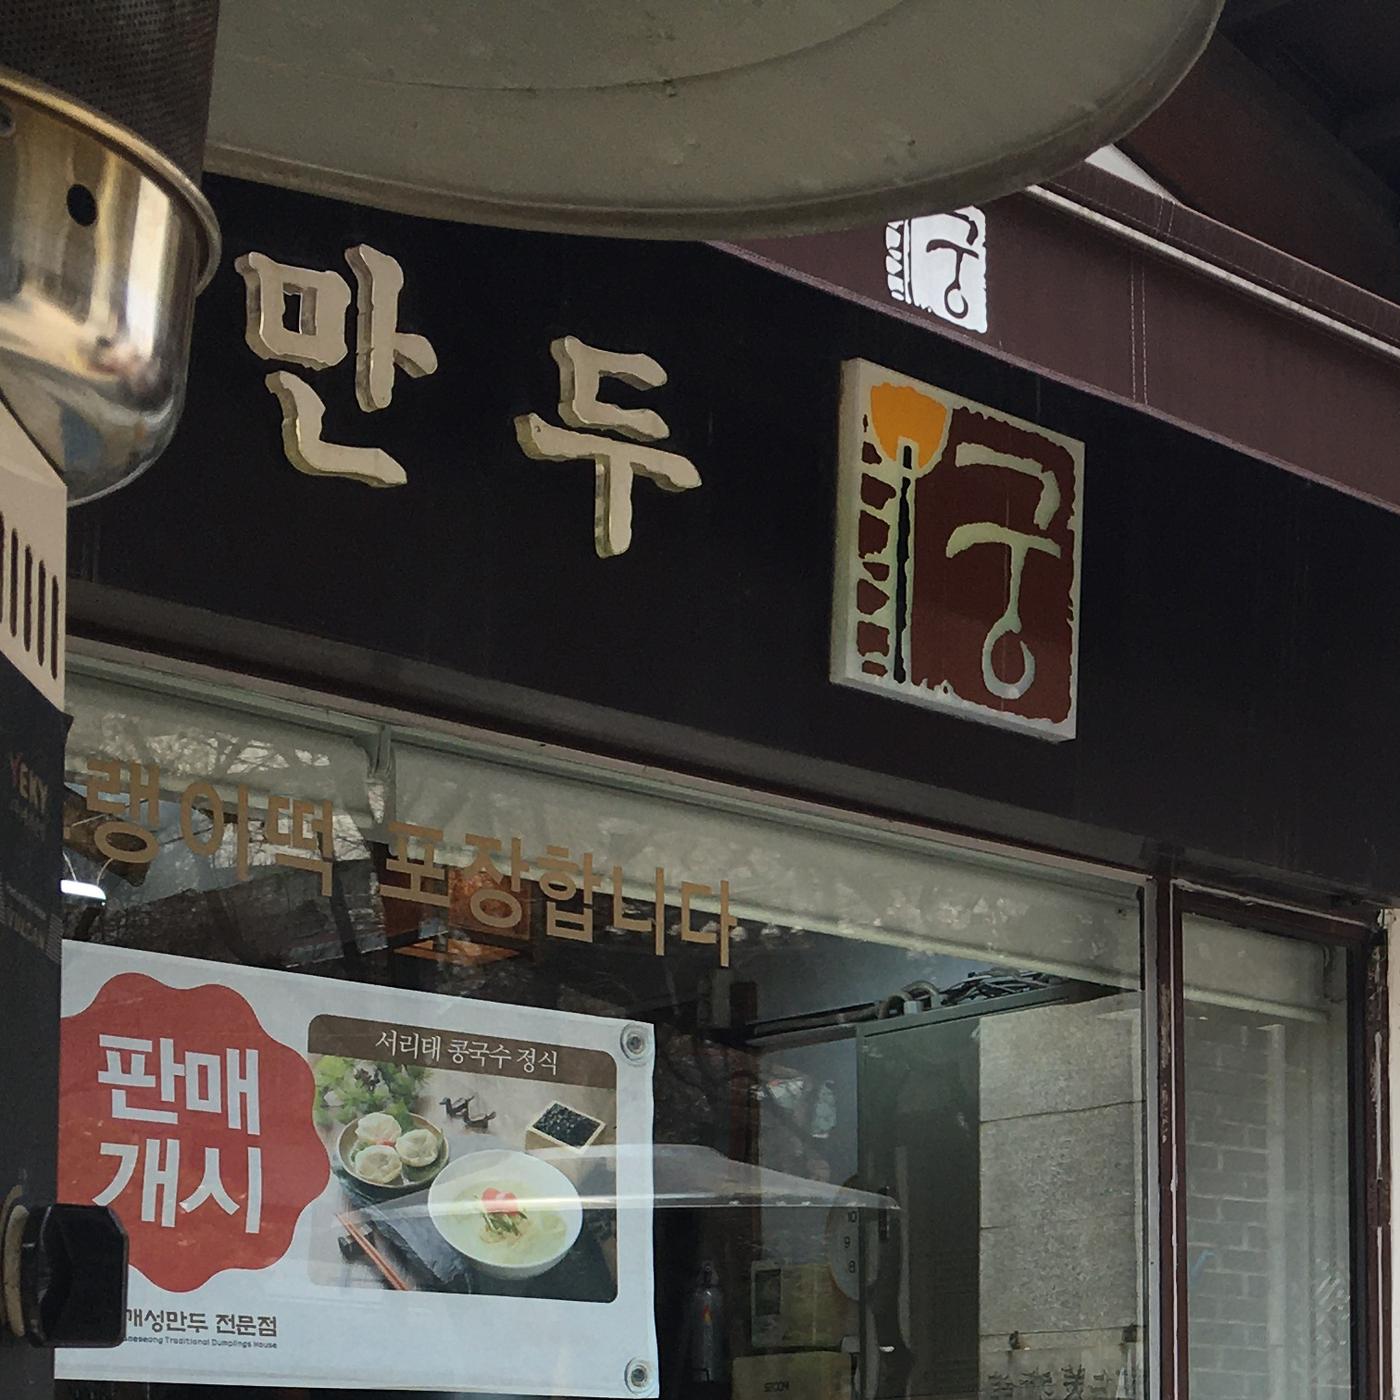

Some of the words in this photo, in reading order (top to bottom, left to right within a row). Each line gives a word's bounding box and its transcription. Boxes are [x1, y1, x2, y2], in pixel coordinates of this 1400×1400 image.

[379, 820, 738, 969] 포장합니다
[98, 1033, 261, 1136] 판매
[375, 1029, 441, 1062] 서리태
[448, 1039, 512, 1069] 콩국수
[516, 1047, 558, 1076] 정식
[92, 1138, 263, 1234] 개시
[124, 1335, 163, 1345] aeseong
[215, 1313, 278, 1337] 전문점
